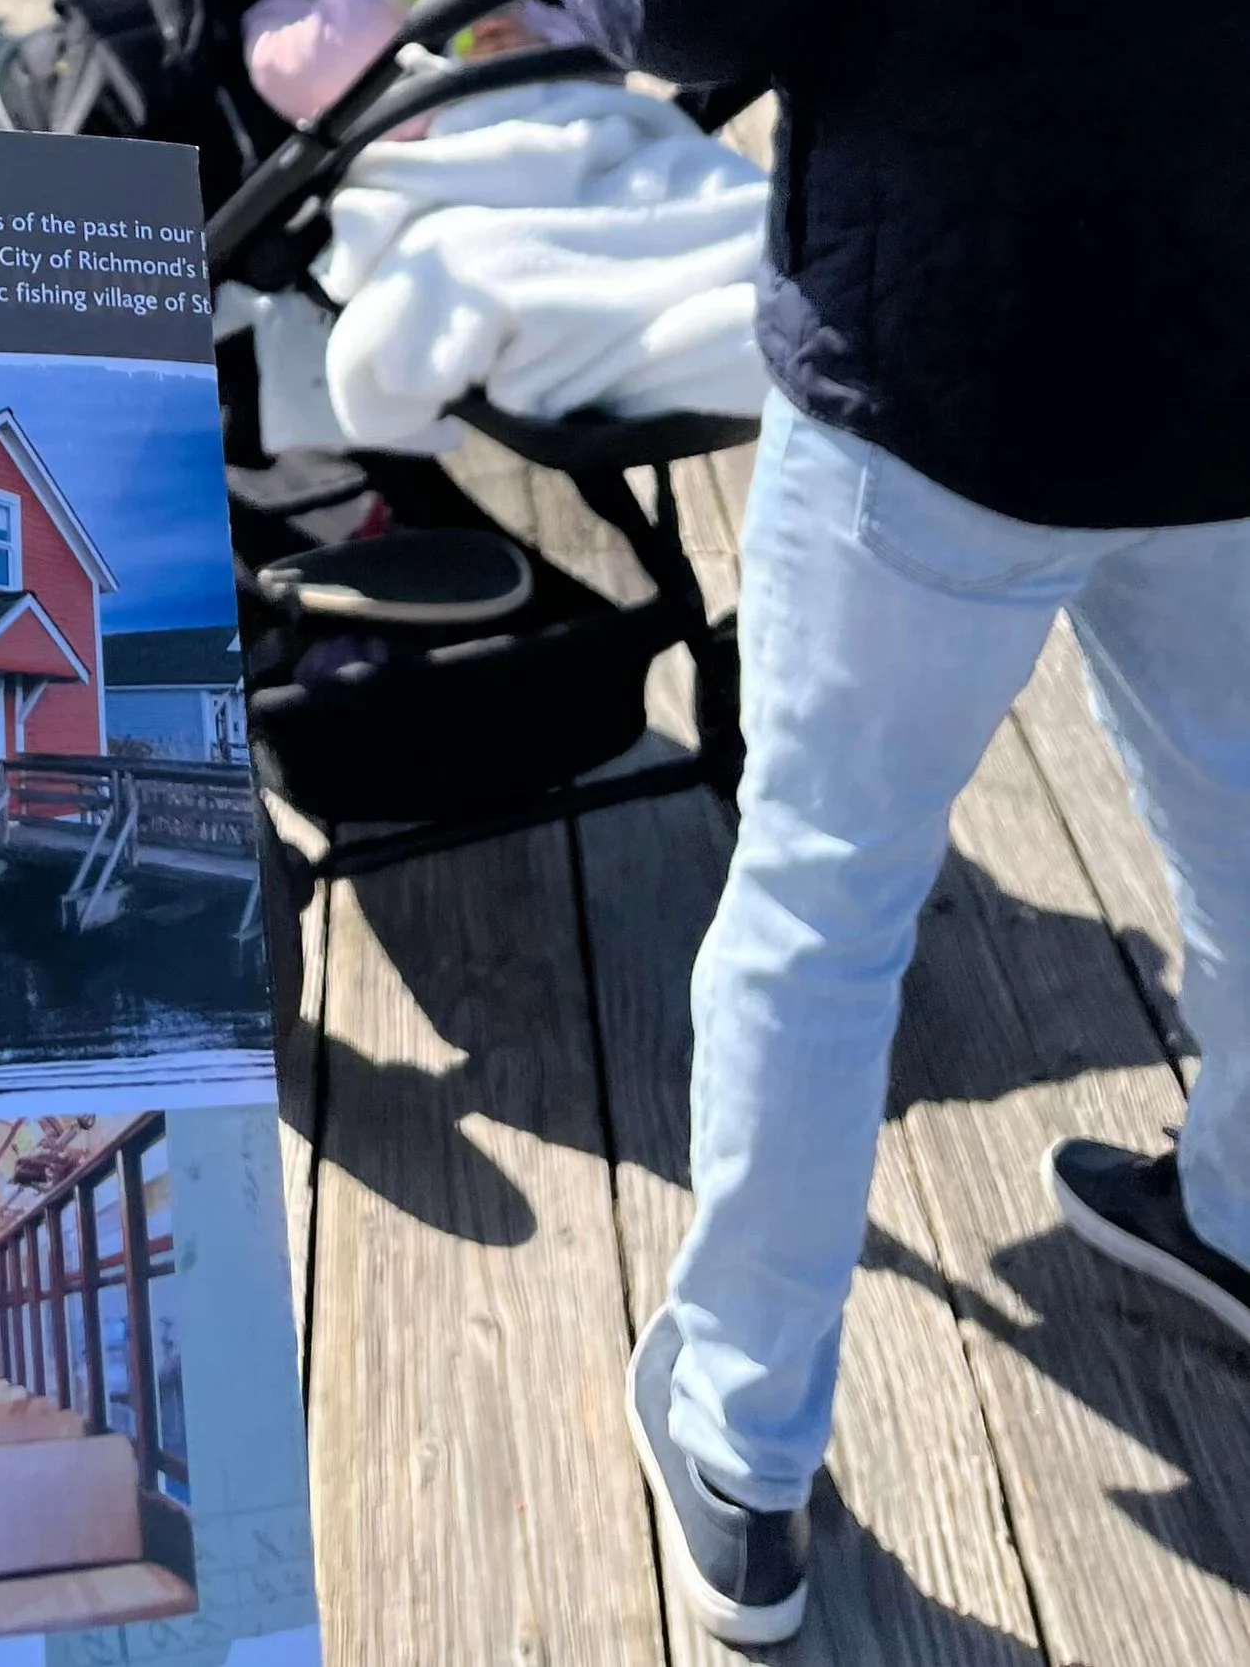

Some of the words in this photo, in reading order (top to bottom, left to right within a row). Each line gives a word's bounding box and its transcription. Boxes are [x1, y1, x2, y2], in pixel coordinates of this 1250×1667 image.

[12, 212, 35, 231] of
[41, 214, 76, 234] the
[84, 220, 128, 242] past
[135, 220, 152, 239] in
[160, 227, 194, 244] our
[0, 246, 42, 274] City
[50, 249, 72, 269] of
[79, 250, 196, 279] Richmond's
[16, 282, 87, 312] fishing
[93, 286, 158, 316] village
[165, 292, 186, 312] of
[192, 293, 213, 314] St
